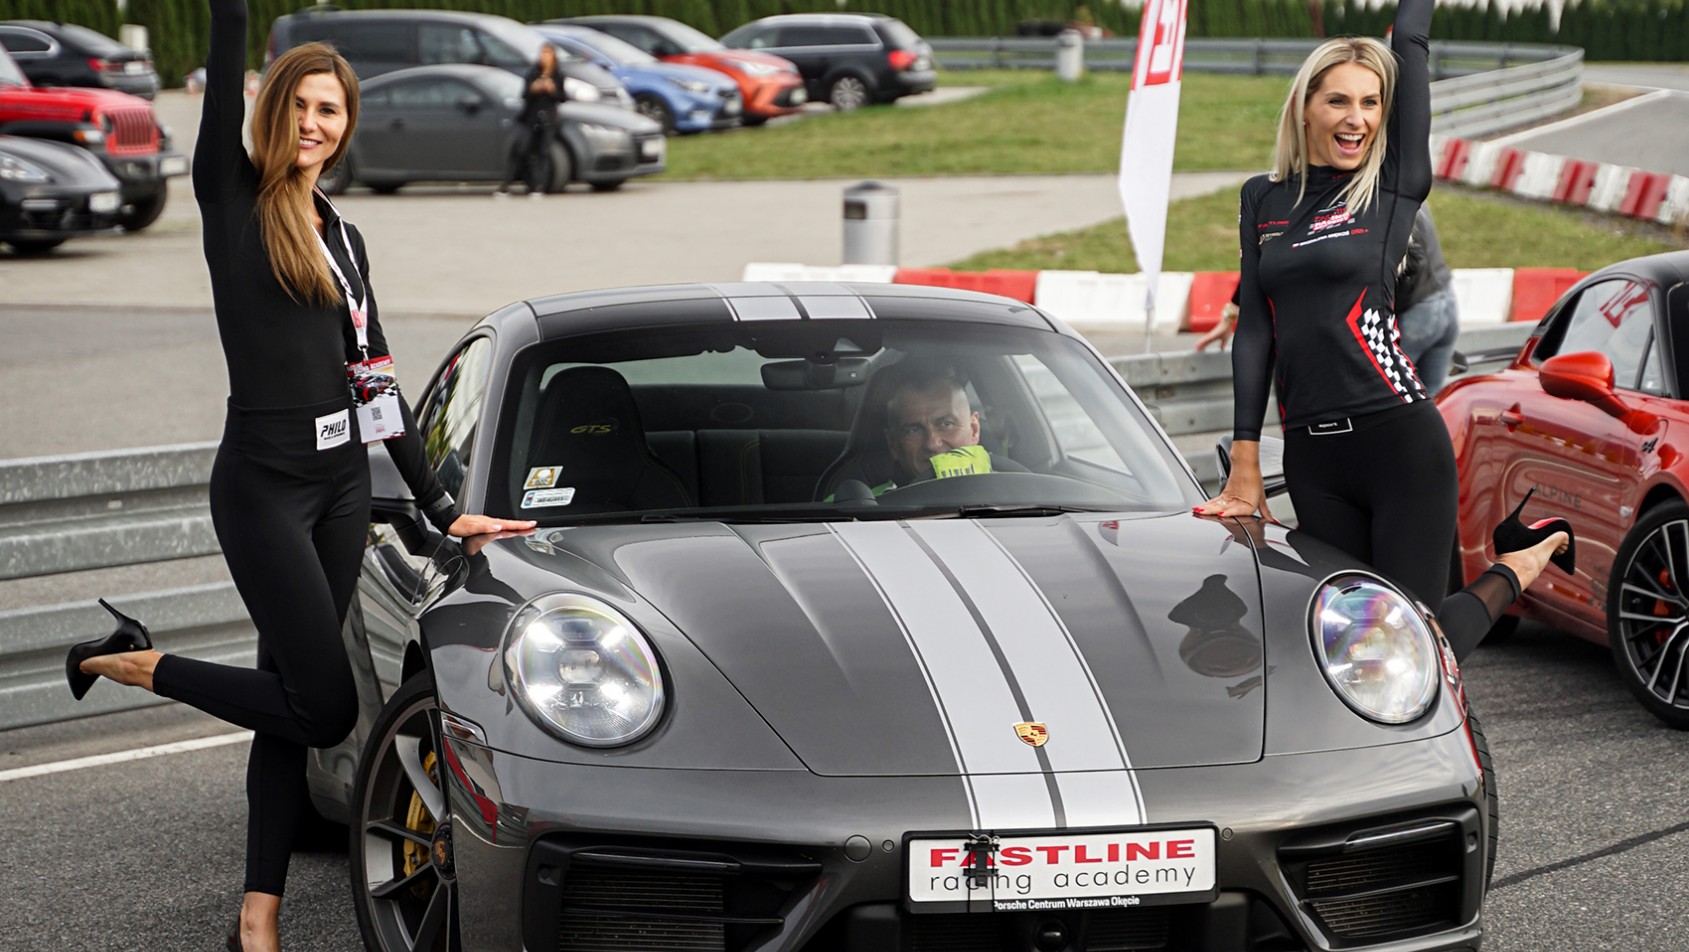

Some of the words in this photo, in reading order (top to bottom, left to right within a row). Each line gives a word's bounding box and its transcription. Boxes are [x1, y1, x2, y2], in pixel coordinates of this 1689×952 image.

[570, 424, 612, 434] GTS
[1533, 483, 1582, 508] ALPINE
[930, 874, 1031, 895] racng
[1053, 864, 1196, 888] academy
[1028, 899, 1066, 910] Centrum
[1067, 898, 1110, 909] Warszawa
